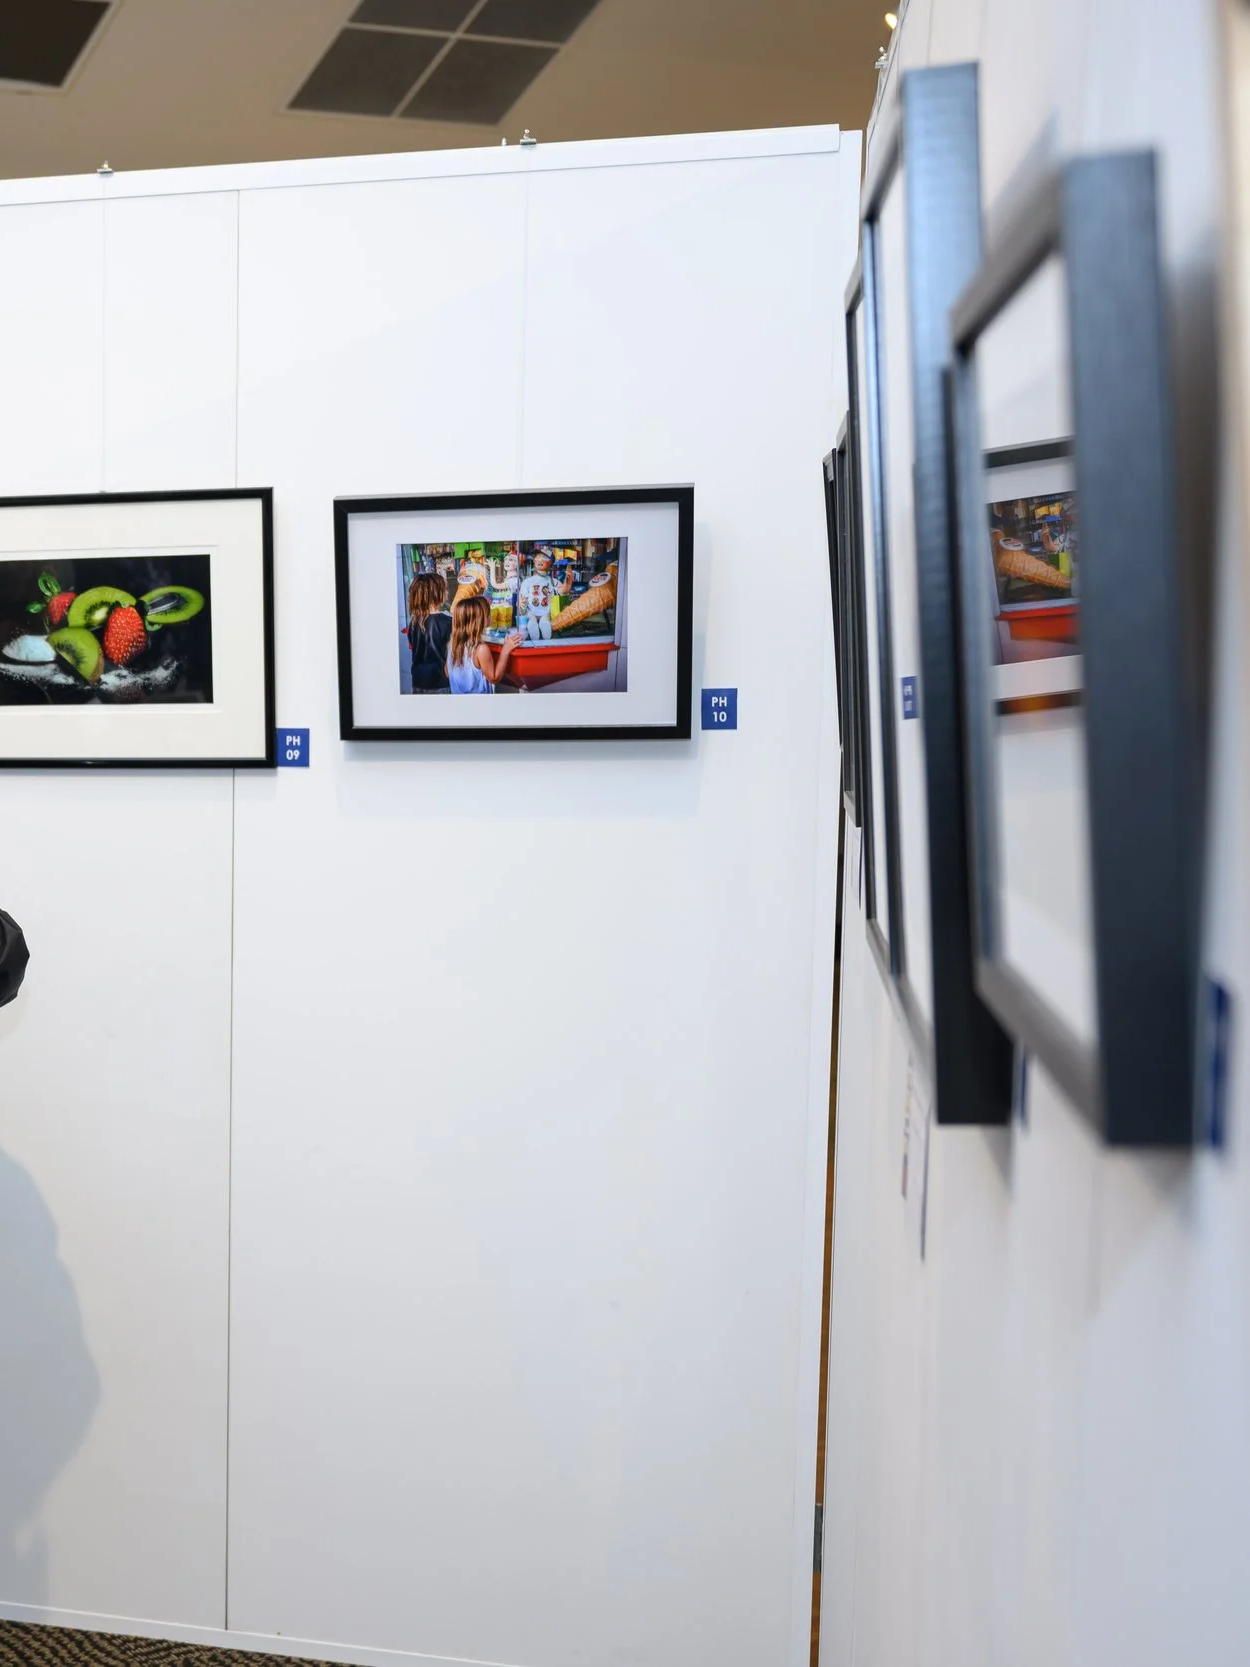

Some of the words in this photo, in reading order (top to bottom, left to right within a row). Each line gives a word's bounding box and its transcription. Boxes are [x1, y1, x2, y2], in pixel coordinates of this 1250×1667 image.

[711, 696, 727, 707] PH
[713, 711, 727, 722] 10
[286, 735, 300, 746] PH
[286, 749, 300, 760] 09
